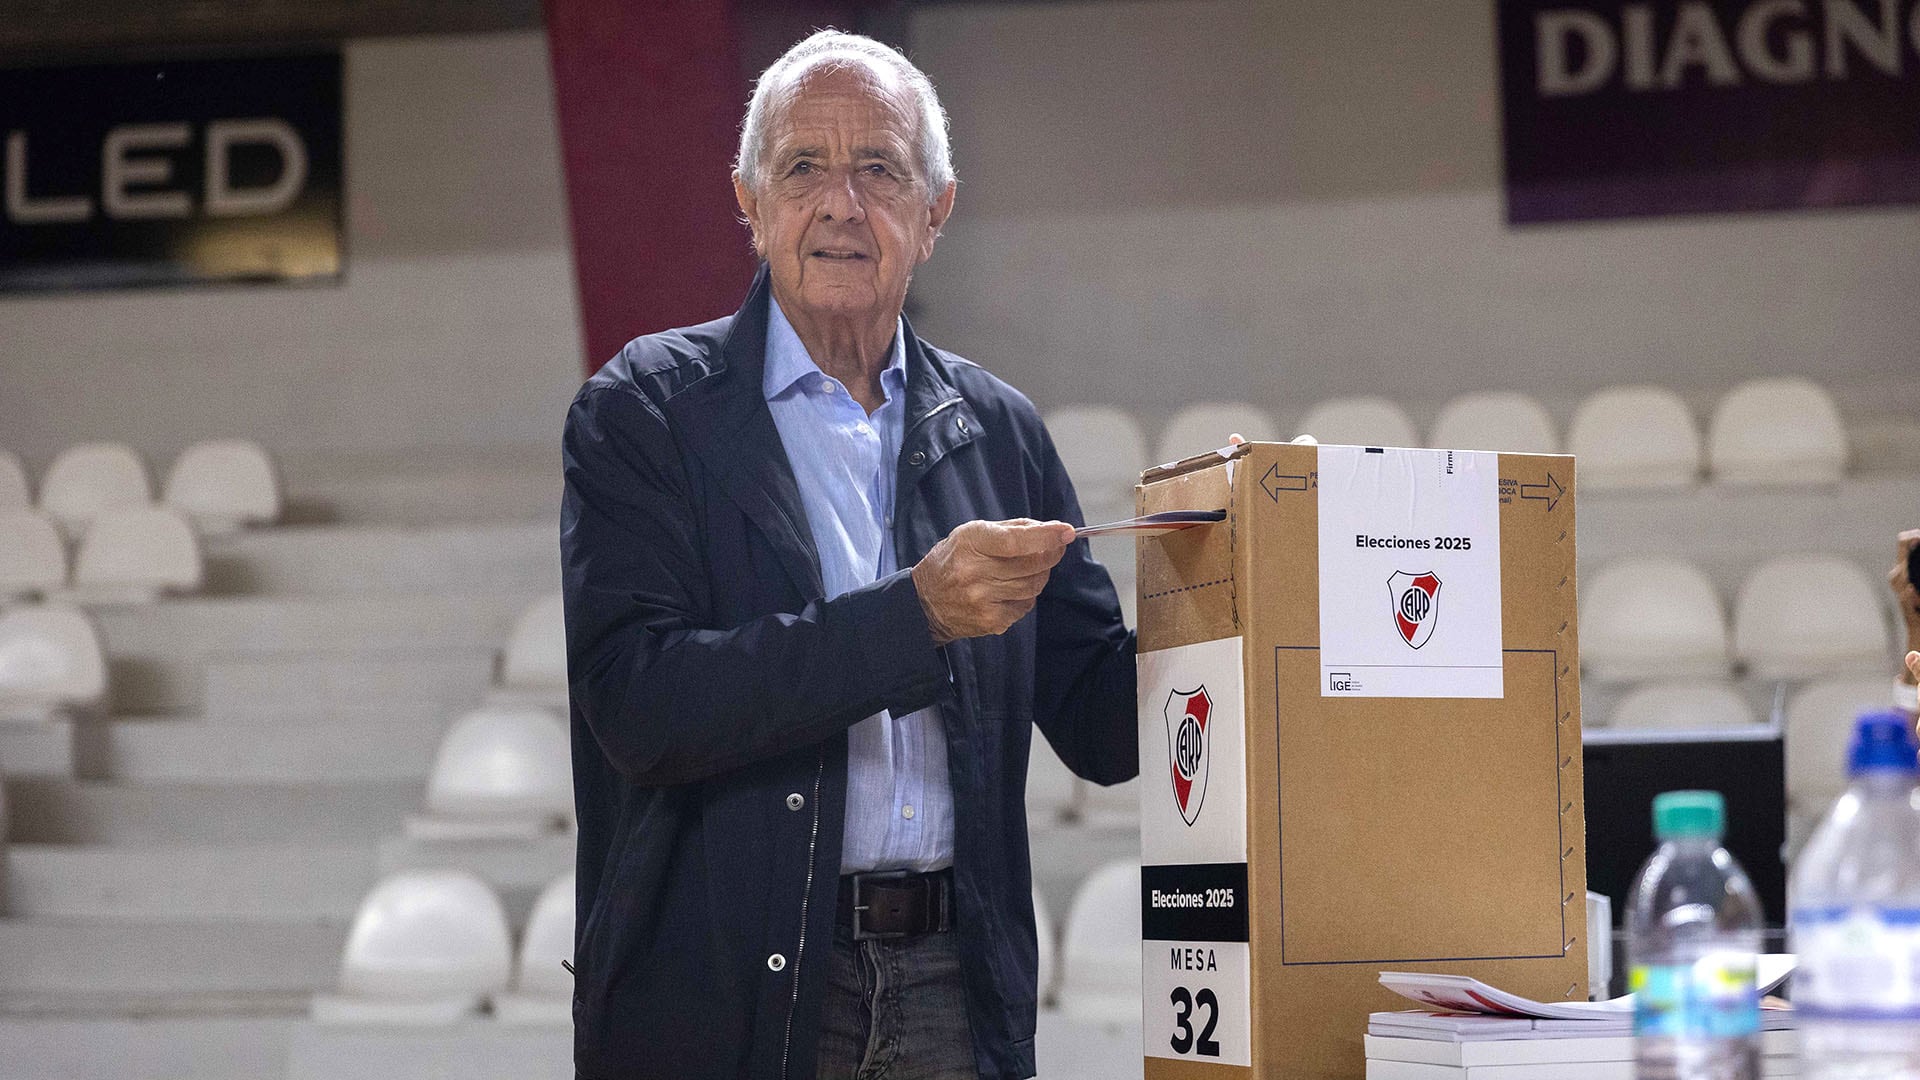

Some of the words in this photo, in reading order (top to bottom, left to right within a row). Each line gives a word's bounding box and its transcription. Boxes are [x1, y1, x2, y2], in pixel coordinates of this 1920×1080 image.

[1535, 0, 1920, 96] DIAGN
[4, 117, 307, 223] LED
[1355, 535, 1431, 549] Elecciones
[1434, 537, 1471, 550] 2025
[1333, 681, 1351, 691] IGE
[1151, 888, 1204, 908] Elecciones
[1205, 888, 1234, 908] 2025
[1170, 947, 1217, 972] MESA
[1170, 986, 1220, 1057] 32
